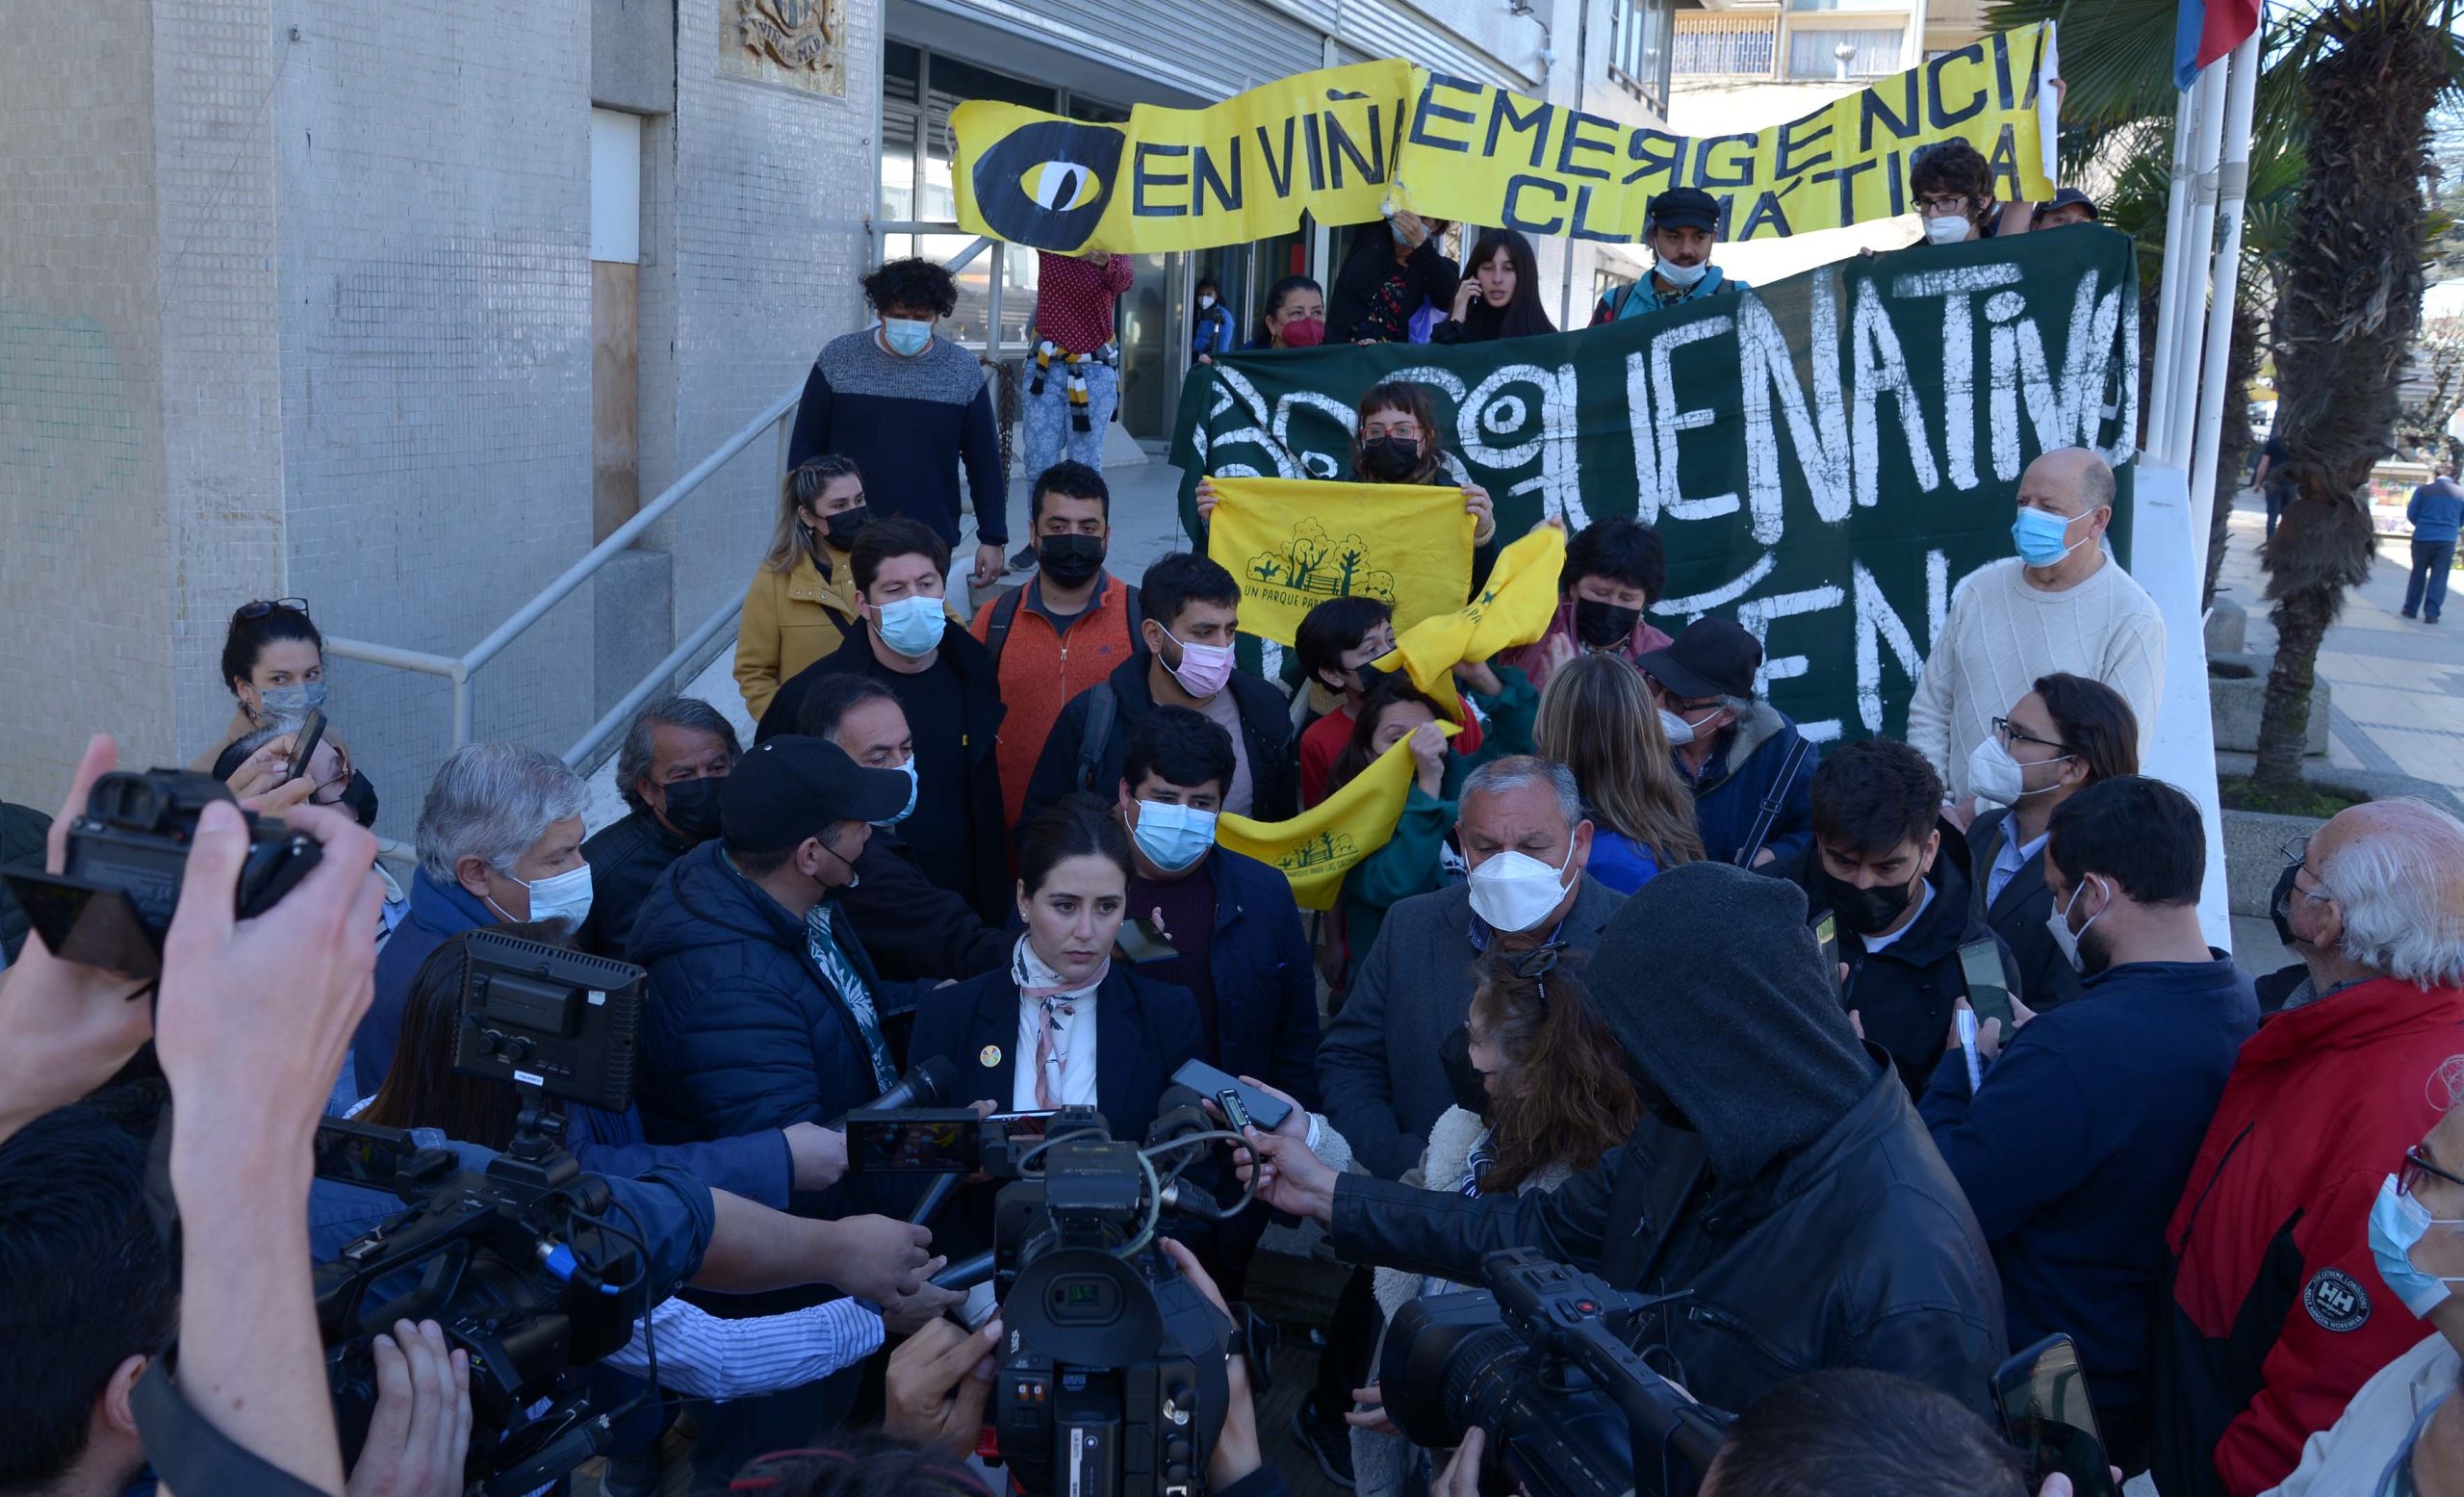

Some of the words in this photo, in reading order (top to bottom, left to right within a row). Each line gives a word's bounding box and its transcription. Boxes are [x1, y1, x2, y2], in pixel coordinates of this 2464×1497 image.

[1132, 135, 1244, 218] EN
[1244, 584, 1259, 598] UN
[1262, 588, 1299, 607] PARQUE
[2321, 1270, 2344, 1279] EXTREME
[2318, 1280, 2354, 1312] HH
